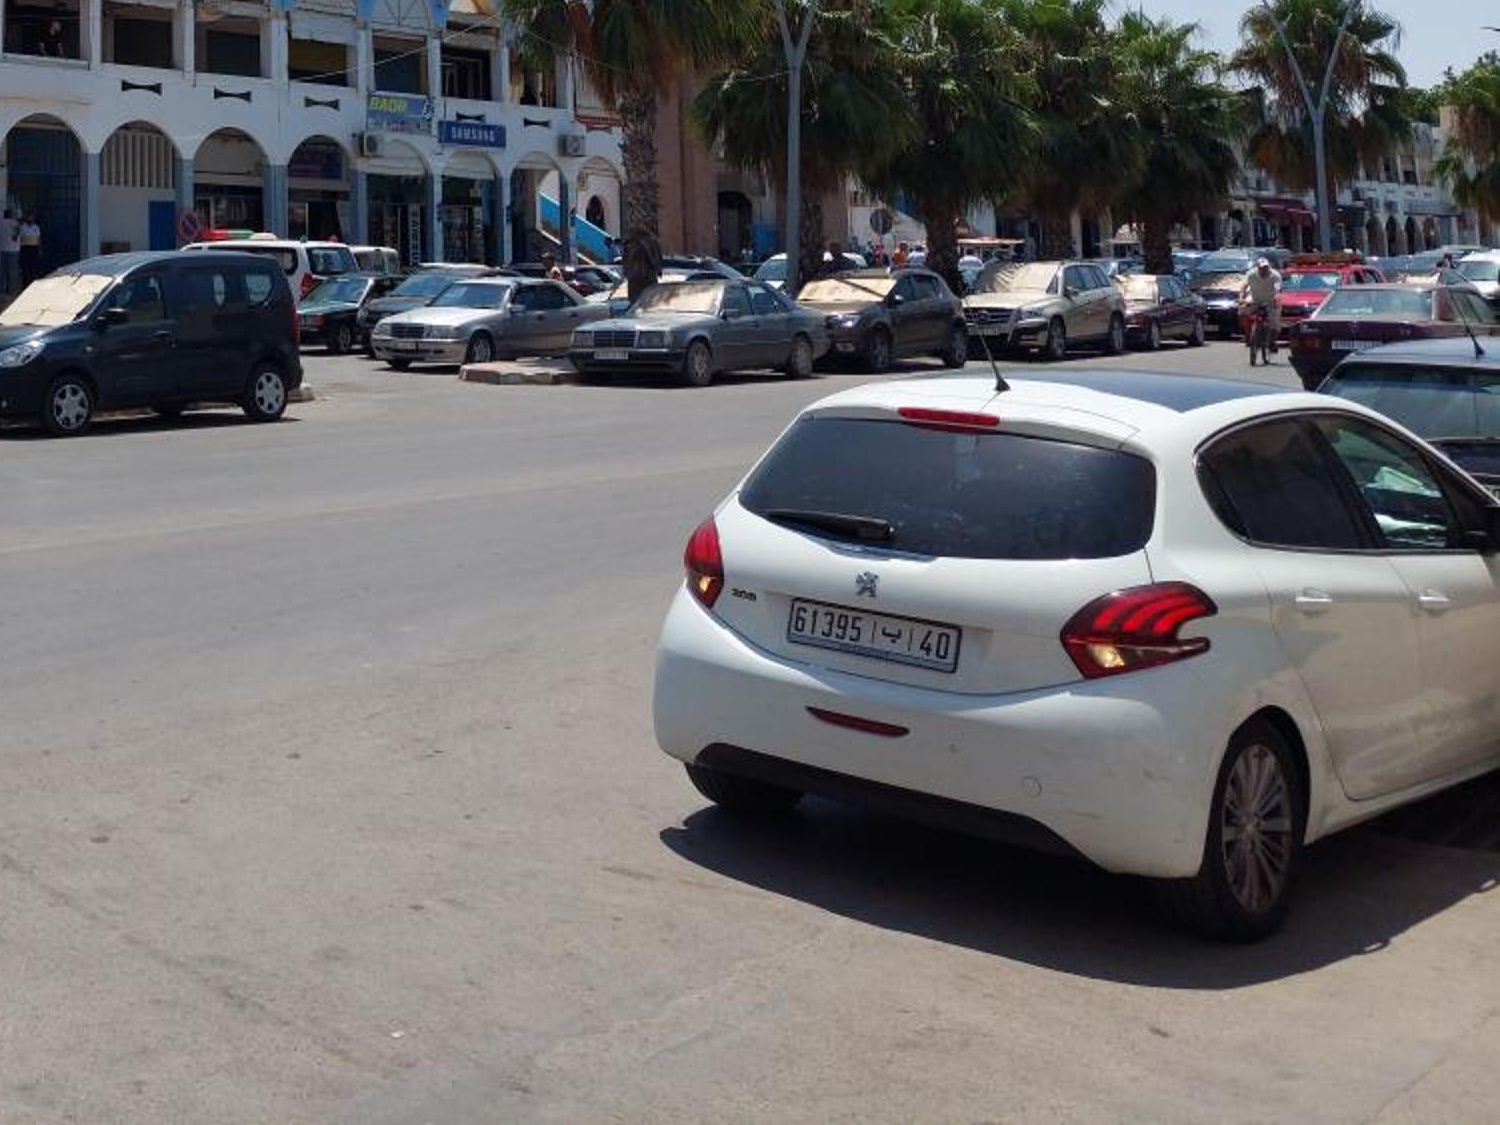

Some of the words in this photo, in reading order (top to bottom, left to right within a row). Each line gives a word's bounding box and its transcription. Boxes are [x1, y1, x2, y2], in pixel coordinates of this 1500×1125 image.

[451, 126, 496, 142] SAMSUNG
[794, 606, 863, 642] 61395
[919, 629, 950, 660] 40
